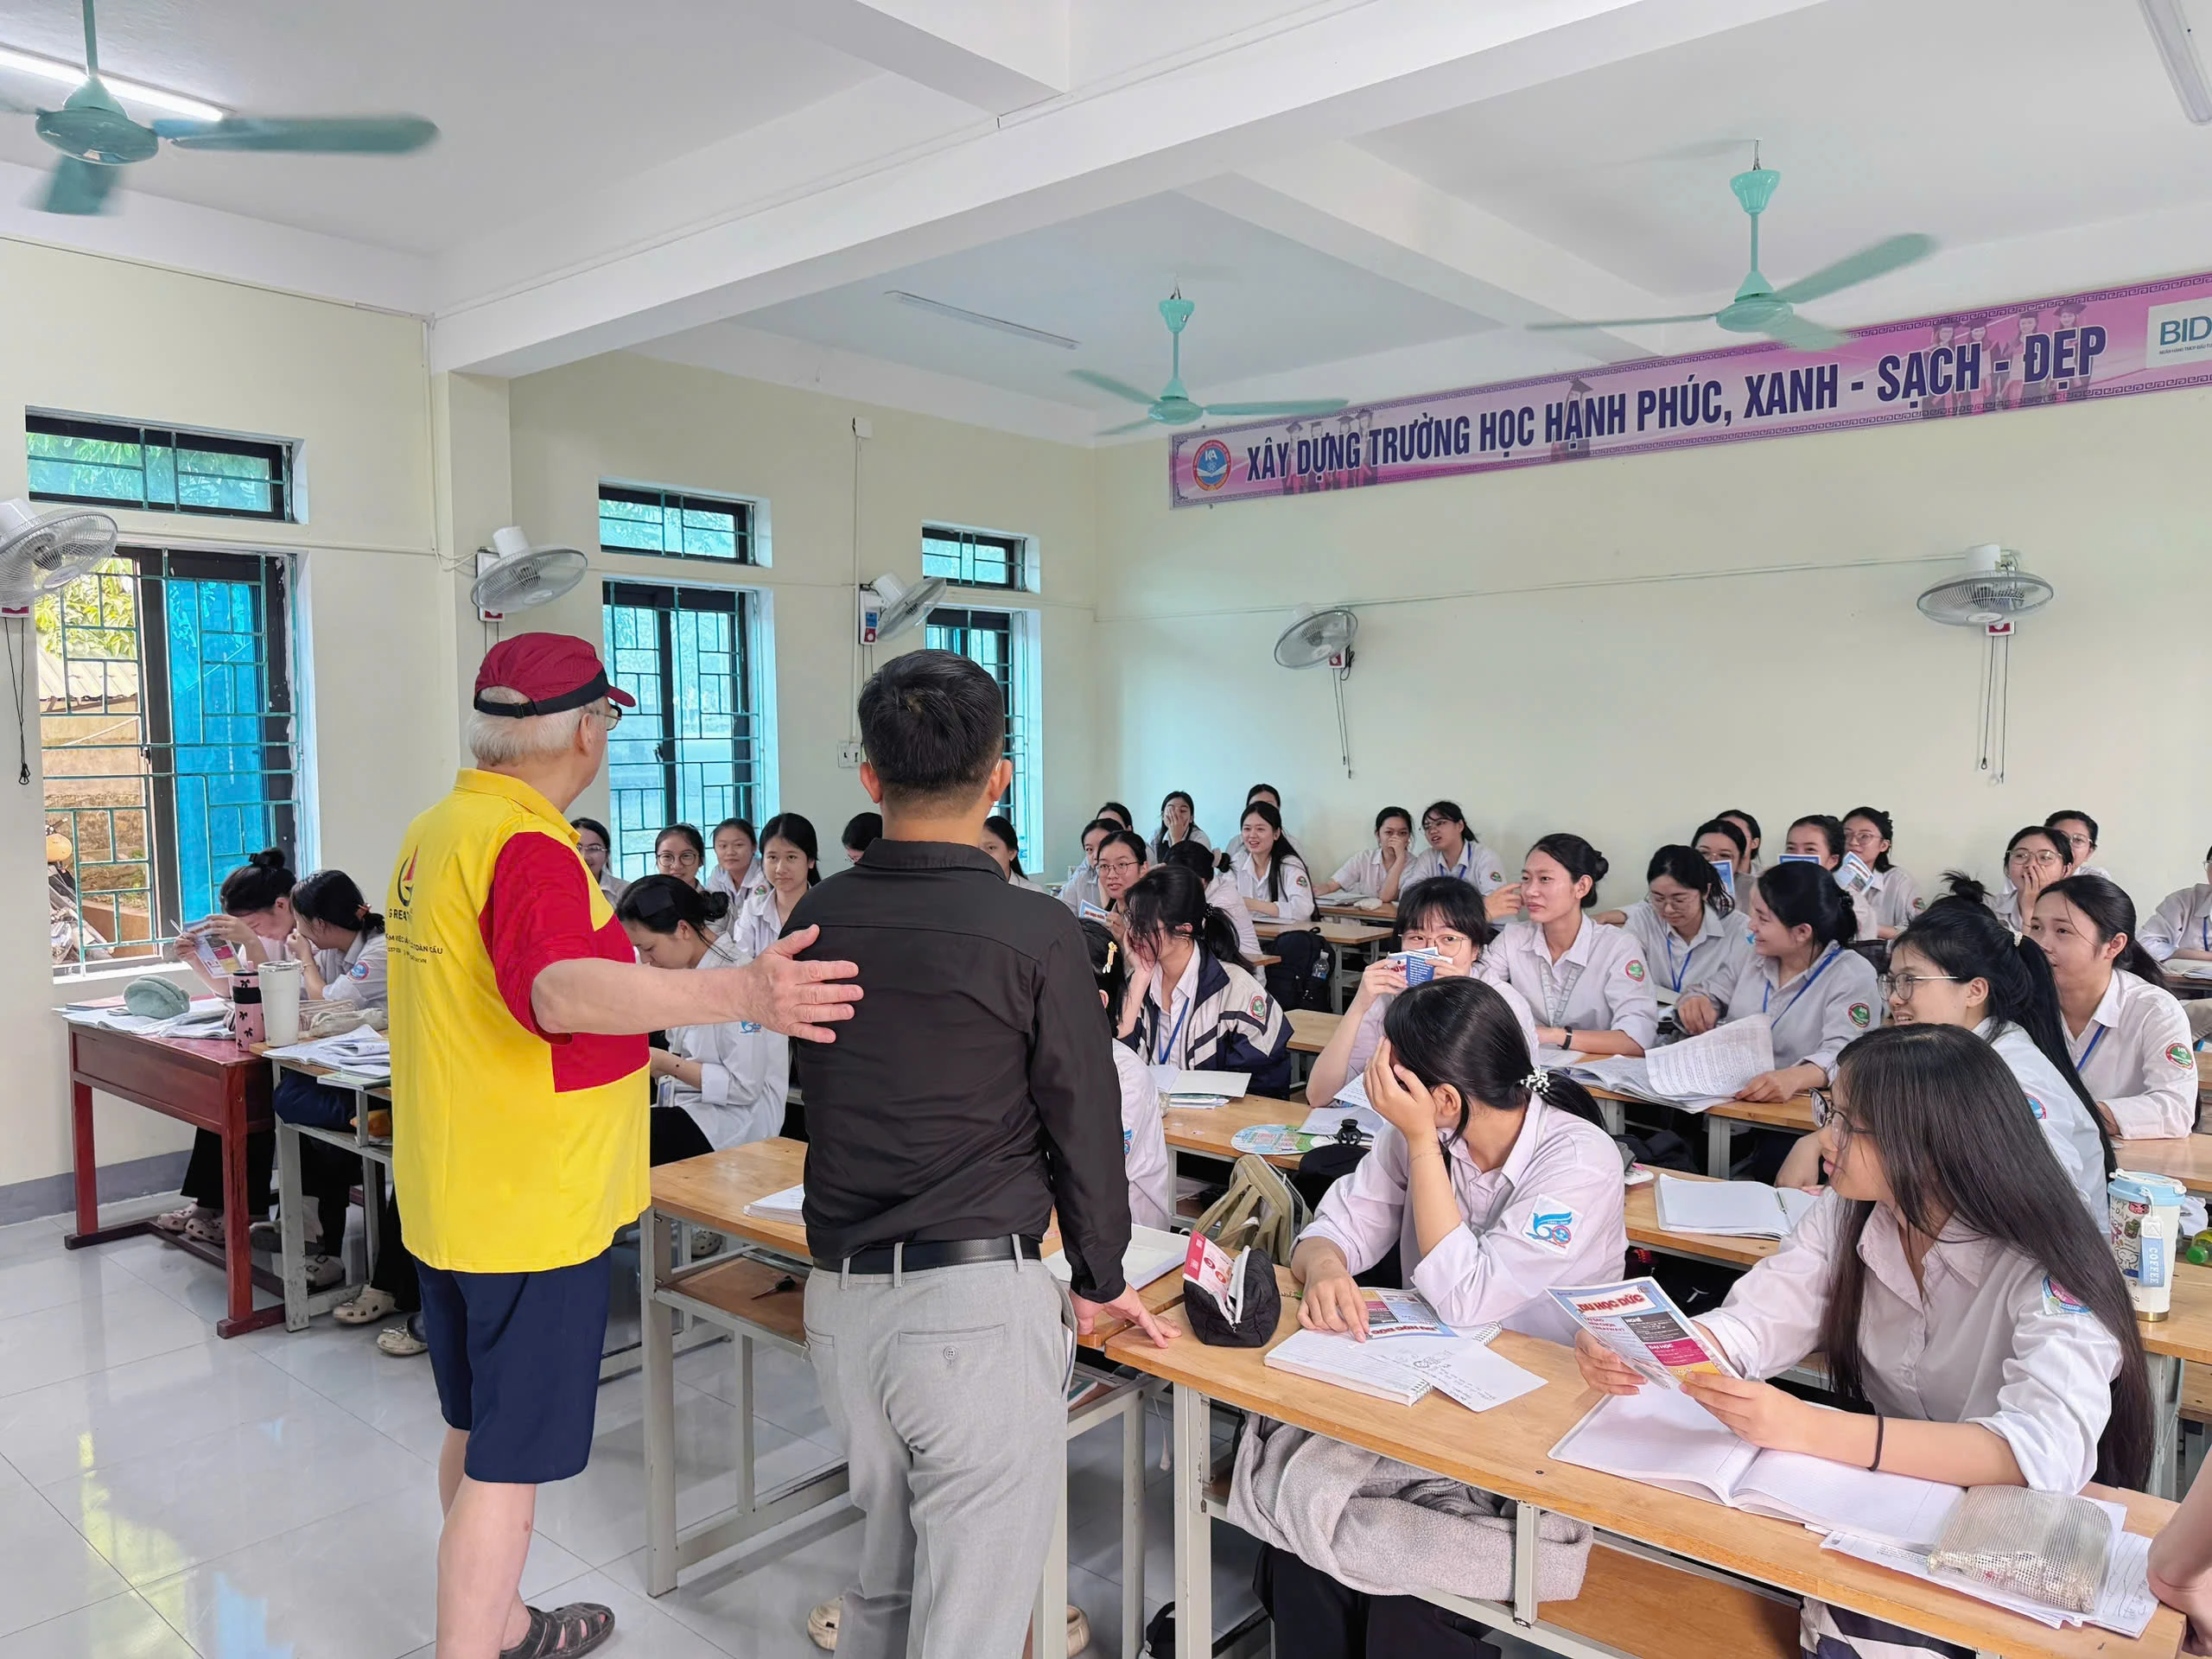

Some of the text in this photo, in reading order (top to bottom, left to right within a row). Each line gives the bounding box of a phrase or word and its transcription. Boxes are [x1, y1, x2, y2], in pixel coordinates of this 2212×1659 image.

[2159, 315, 2212, 346] BID
[1246, 435, 1290, 481] XÂY
[1296, 432, 1362, 481] DỰNG
[1368, 411, 1471, 467] TRƯỜNG
[1478, 406, 1535, 458] HỌC
[1544, 392, 1627, 450] HẠNH
[1636, 374, 1732, 429] PHÚC,
[1742, 363, 1839, 419] XANH
[1876, 343, 1981, 409] SẠCH
[2022, 325, 2107, 391] ĐẸP
[2149, 1247, 2159, 1284] COFFEE
